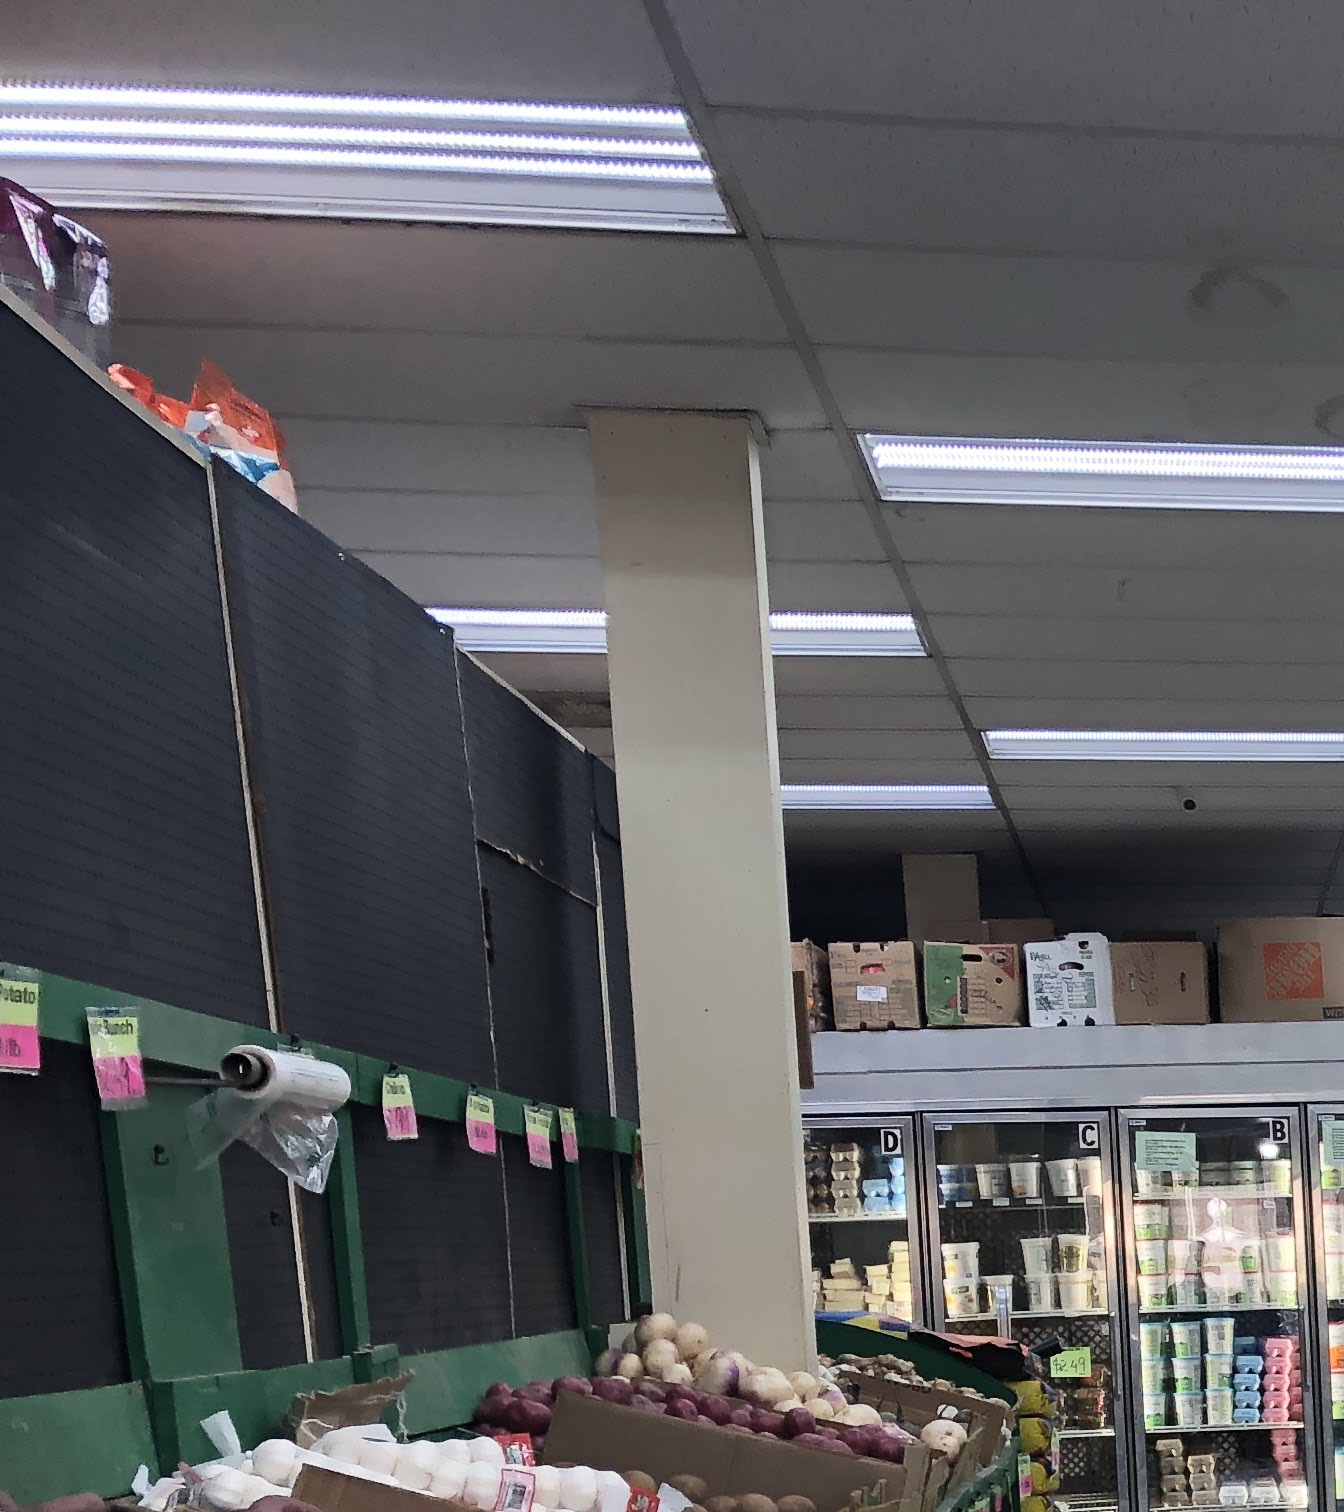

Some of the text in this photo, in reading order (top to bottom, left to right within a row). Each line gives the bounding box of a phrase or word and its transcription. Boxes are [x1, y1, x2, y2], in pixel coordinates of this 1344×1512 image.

[883, 1130, 900, 1152] D
[1081, 1124, 1097, 1147] C
[1271, 1122, 1287, 1142] B
[1052, 1356, 1086, 1375] $2.49
